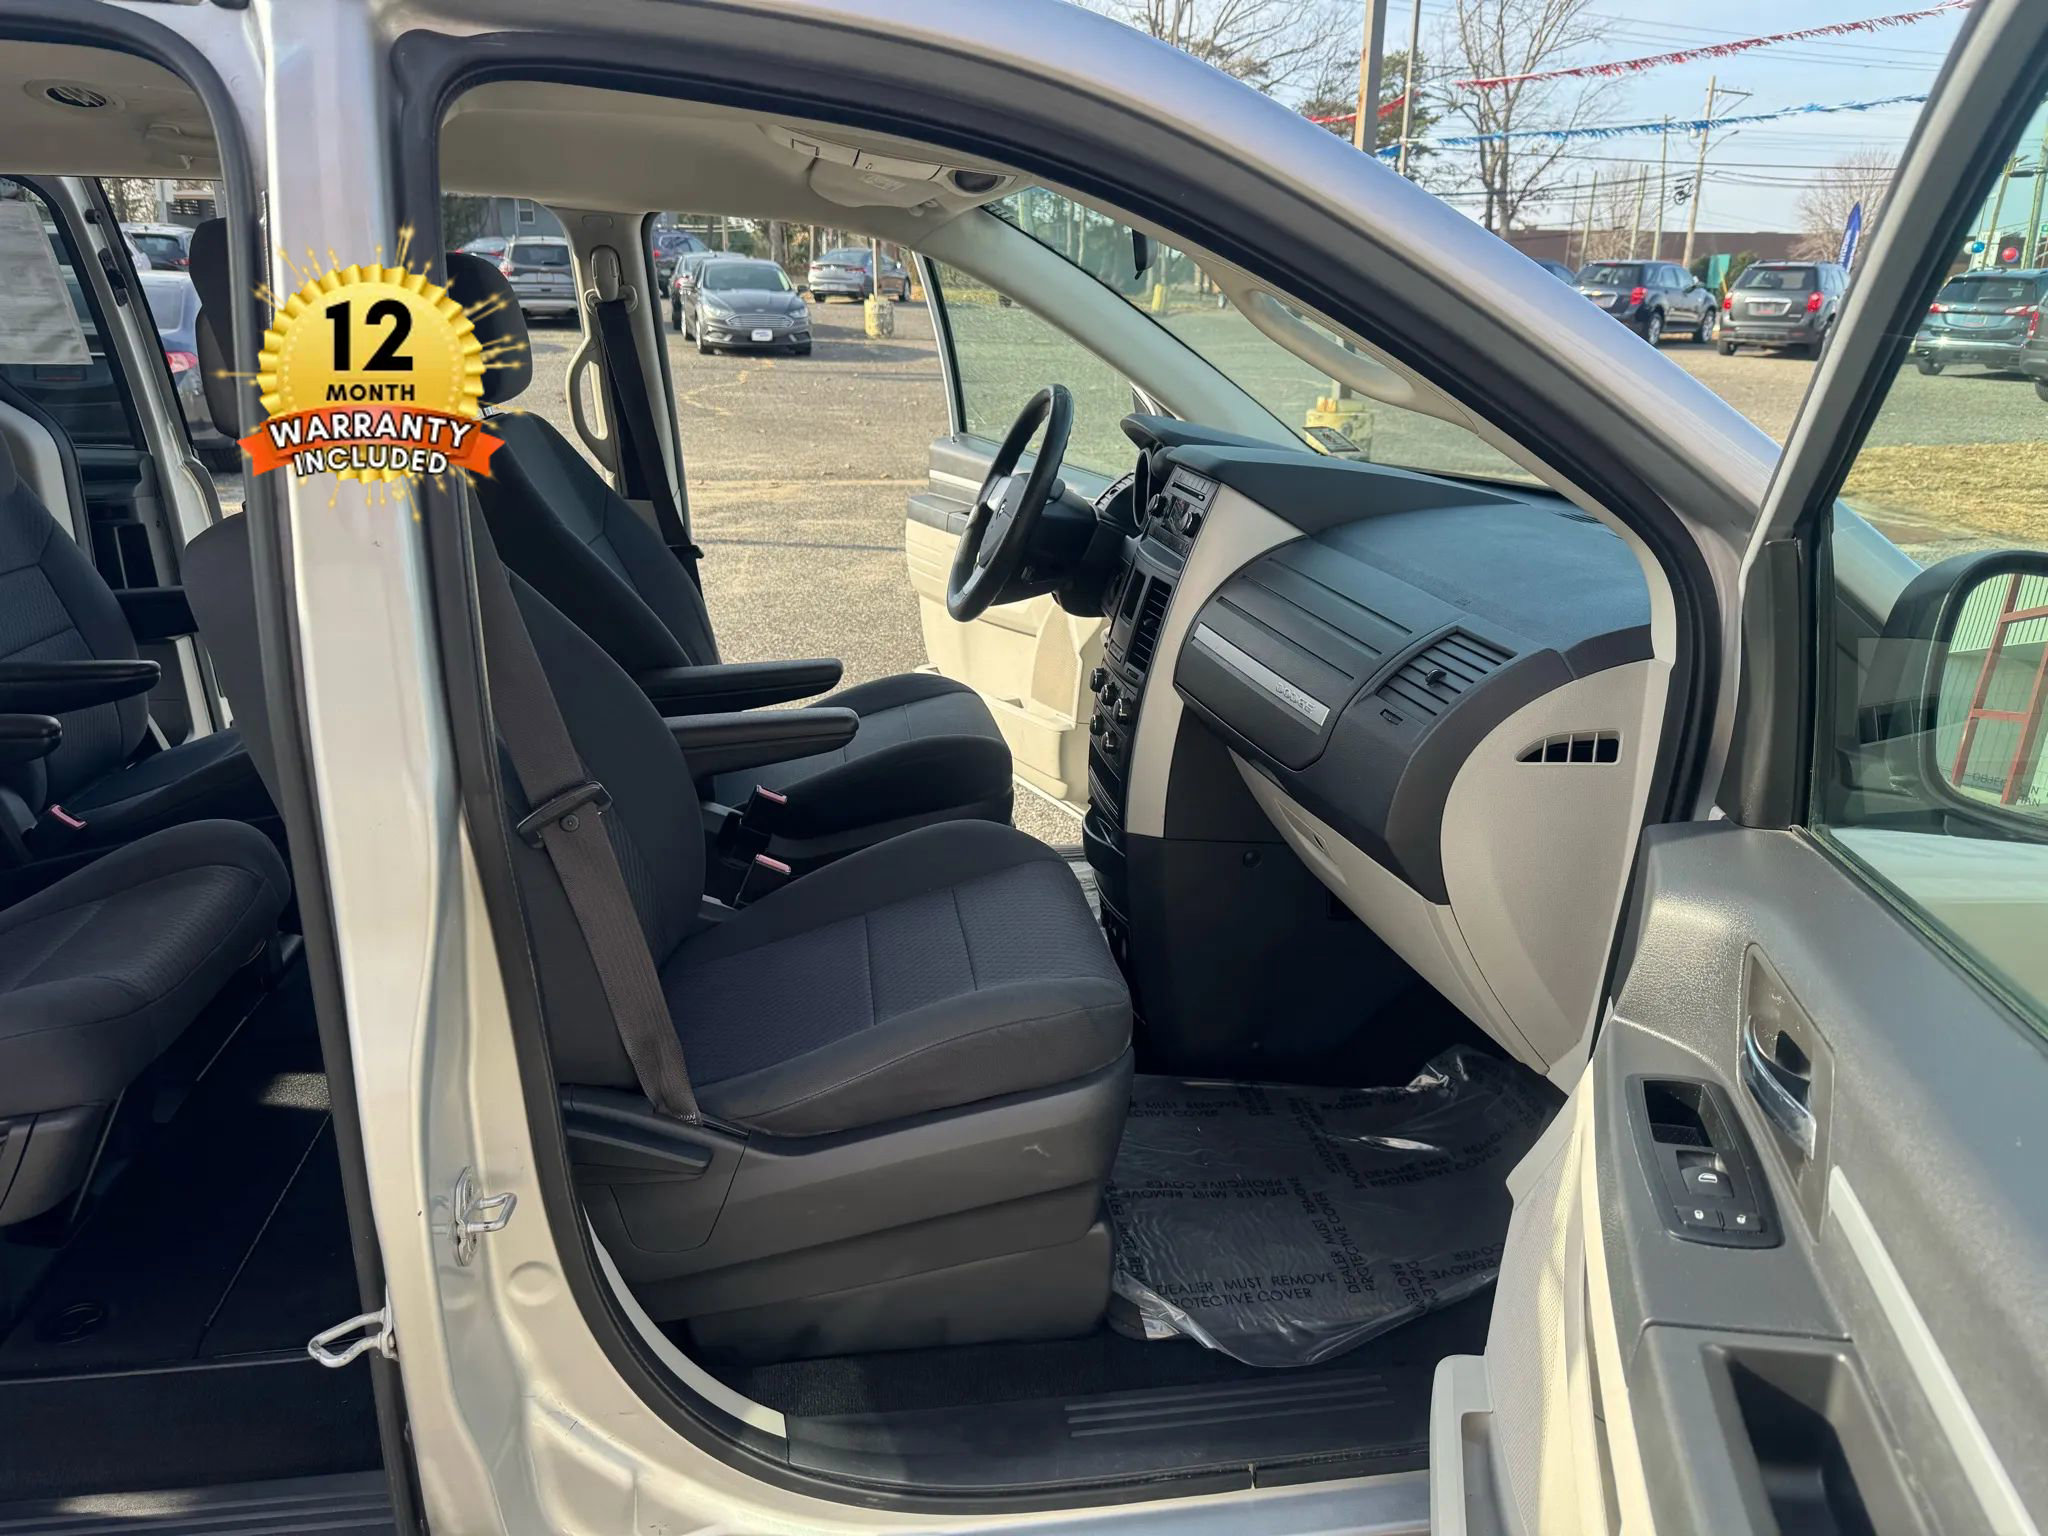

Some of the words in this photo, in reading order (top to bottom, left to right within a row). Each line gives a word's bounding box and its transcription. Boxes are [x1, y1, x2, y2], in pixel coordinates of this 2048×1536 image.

[1275, 681, 1316, 714] DODGE
[1312, 1191, 1341, 1224] COVER
[1311, 1218, 1336, 1245] MUST
[1330, 1250, 1361, 1293] DEALER
[1333, 1225, 1376, 1292] PROTECTIVE
[1156, 1281, 1214, 1296] DEALER
[1223, 1276, 1262, 1291] MUST
[1272, 1271, 1337, 1287] REMOVE
[1169, 1291, 1254, 1309] ROTECTIVE
[1257, 1287, 1312, 1303] COVER
